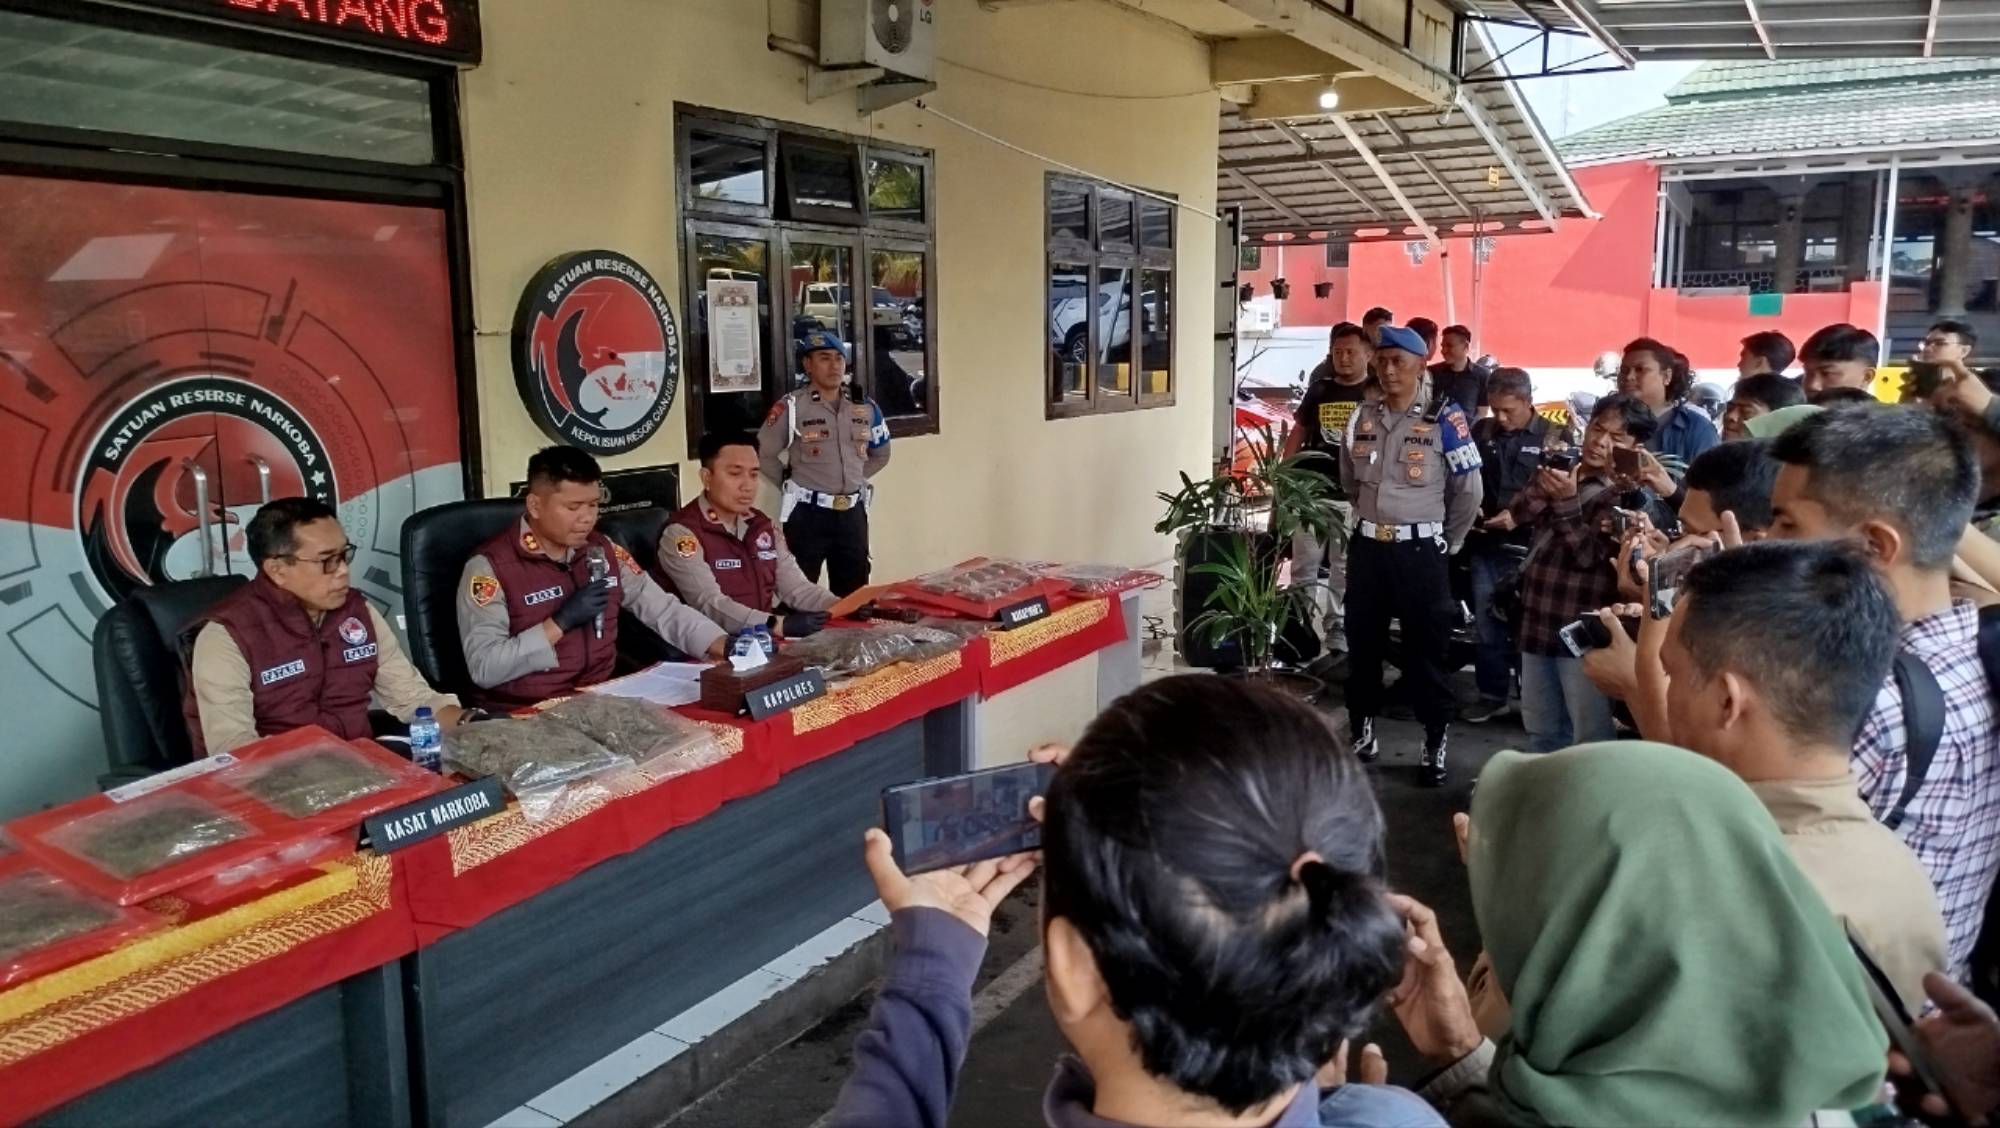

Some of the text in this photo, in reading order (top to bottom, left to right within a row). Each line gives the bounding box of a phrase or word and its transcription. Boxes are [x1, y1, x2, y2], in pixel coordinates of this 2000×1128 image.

[229, 0, 448, 44] ANG
[920, 8, 932, 24] LG
[546, 259, 593, 303] SATUAN
[595, 258, 649, 289] RESERSE
[647, 286, 677, 357] NARKOBA
[104, 389, 316, 466] SATUAN RESERSE NARKOBA
[626, 419, 653, 444] RESOR
[652, 378, 676, 422] CIANJUR
[1404, 437, 1433, 447] POLRI
[763, 680, 815, 709] KAPOLRES
[384, 791, 490, 841] KASAT NARKOBA
